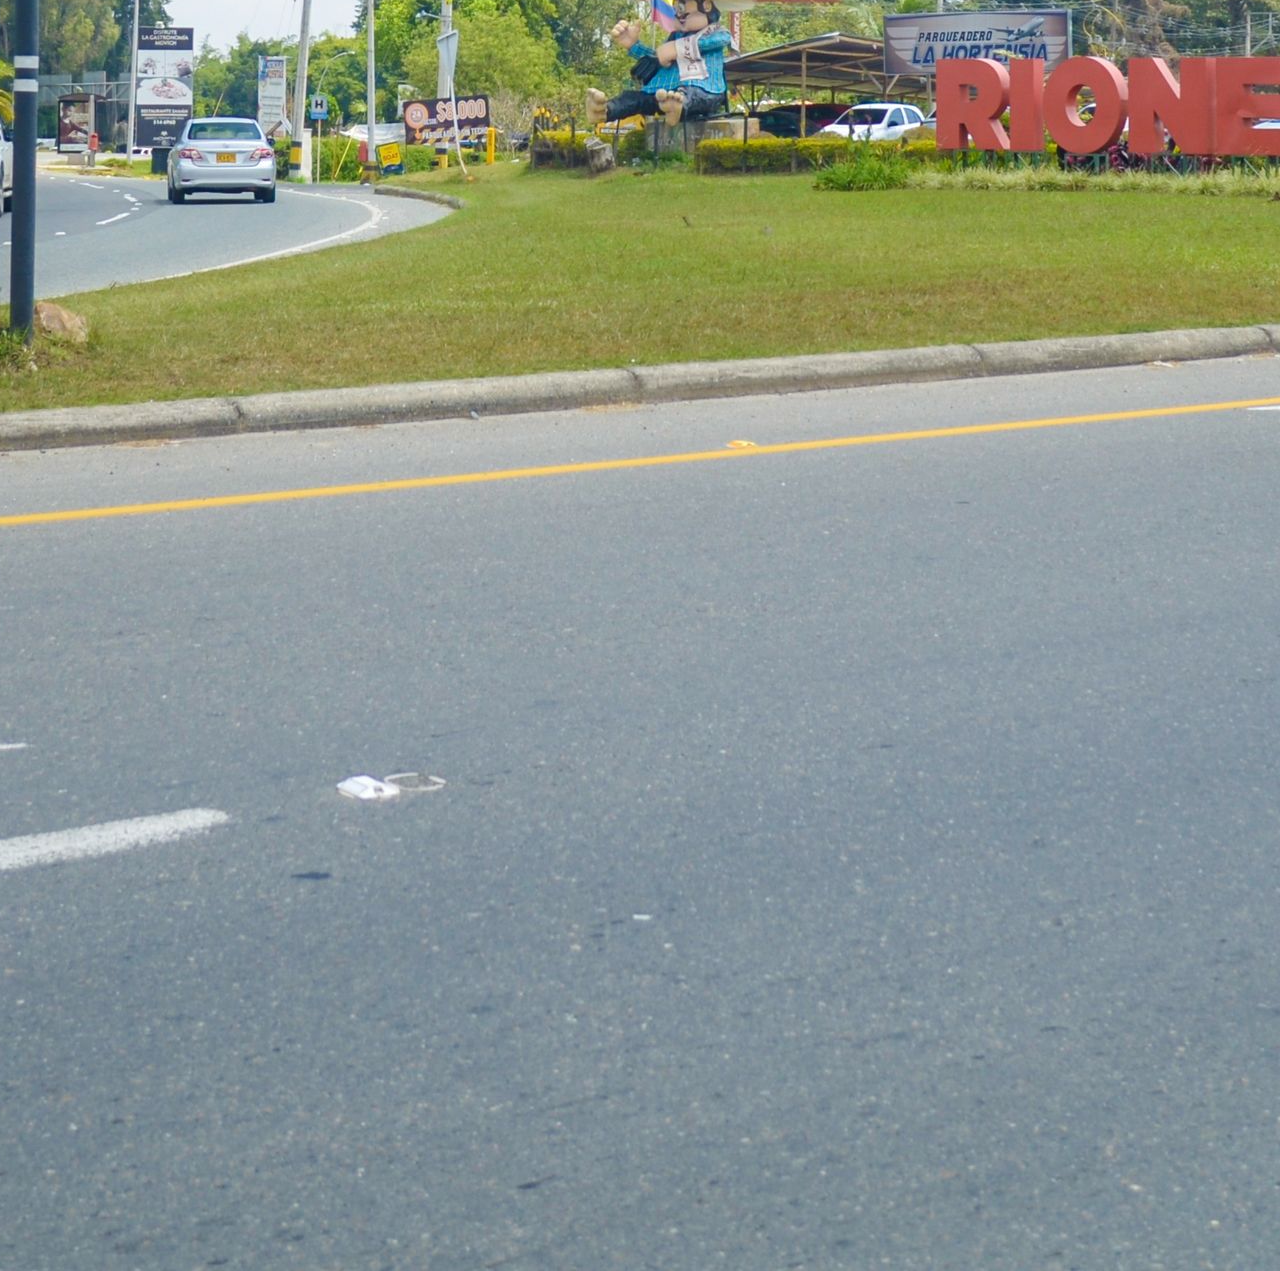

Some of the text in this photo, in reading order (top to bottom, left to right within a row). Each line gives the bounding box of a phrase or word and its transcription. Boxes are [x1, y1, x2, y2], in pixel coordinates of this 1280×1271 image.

[918, 30, 993, 43] PARQUEADERO
[911, 43, 1048, 65] LA HORTENSIA
[315, 99, 324, 109] H
